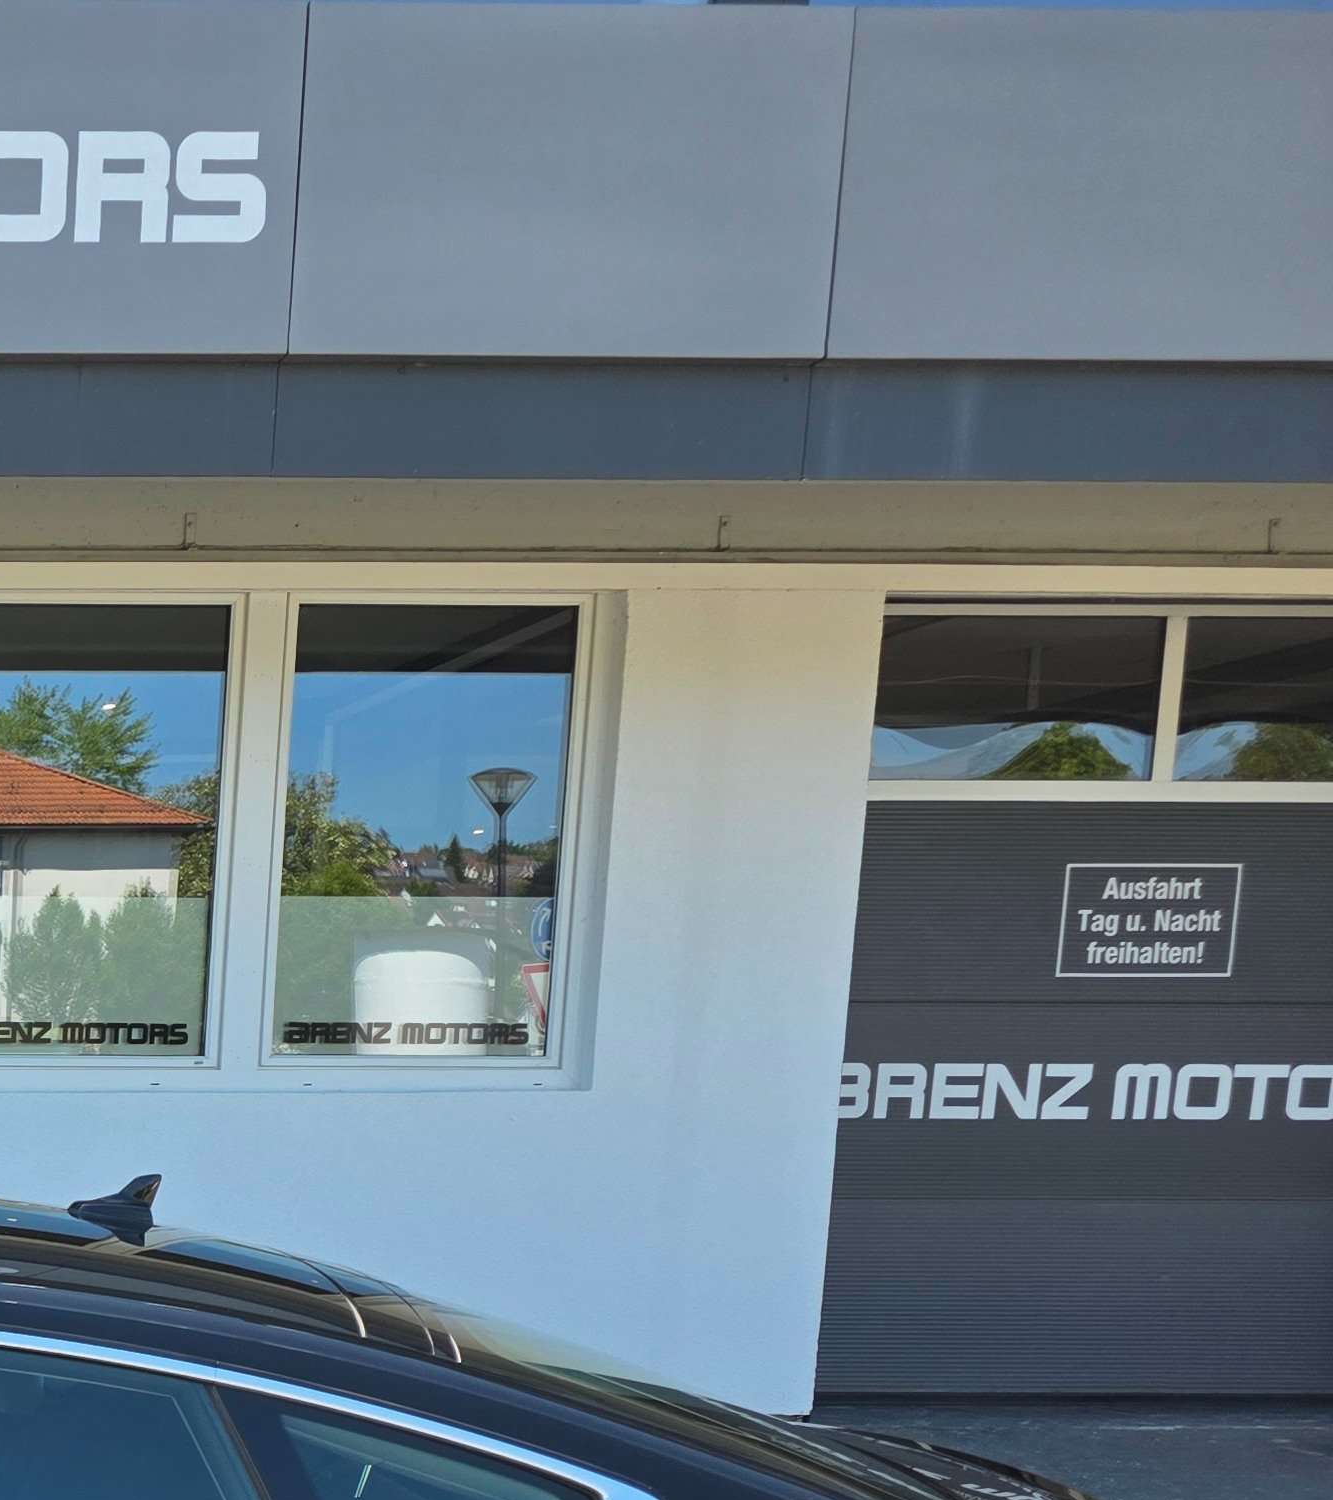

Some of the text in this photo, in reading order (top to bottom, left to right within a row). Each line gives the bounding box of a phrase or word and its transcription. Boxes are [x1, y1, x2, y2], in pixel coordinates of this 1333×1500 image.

[1102, 877, 1203, 900] Ausfahrt
[1078, 909, 1222, 937] Tag u. Nacht
[1086, 941, 1205, 964] freihalten!
[61, 1022, 189, 1045] MOTORS
[285, 1021, 529, 1045] BRENZ MOTORS
[837, 1062, 1094, 1120] BRENZ
